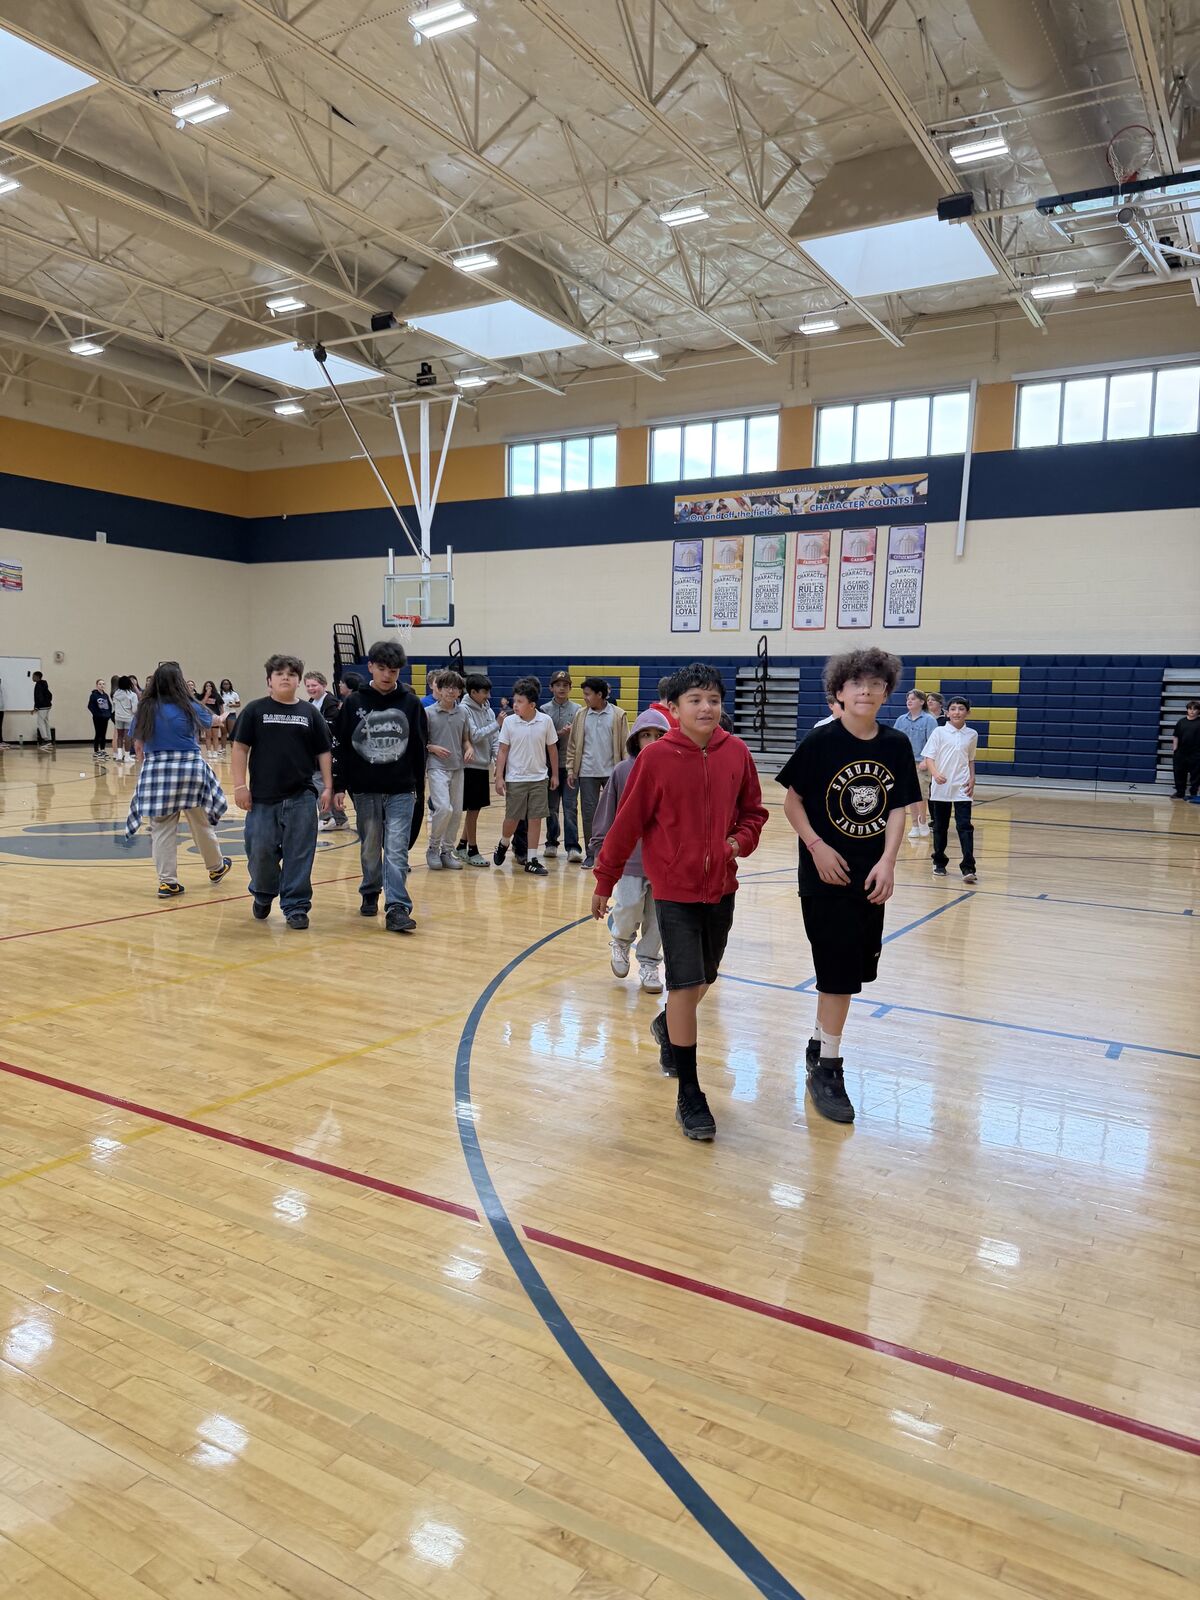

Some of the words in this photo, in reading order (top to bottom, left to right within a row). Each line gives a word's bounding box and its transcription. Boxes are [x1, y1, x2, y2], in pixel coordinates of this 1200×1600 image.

[809, 501, 865, 512] CHARACTER
[868, 496, 914, 507] COUNTS!
[722, 511, 734, 519] off
[737, 510, 752, 518] the
[798, 585, 824, 593] RULES
[832, 763, 894, 792] SAHUARITA
[835, 816, 887, 836] JAGUARS
